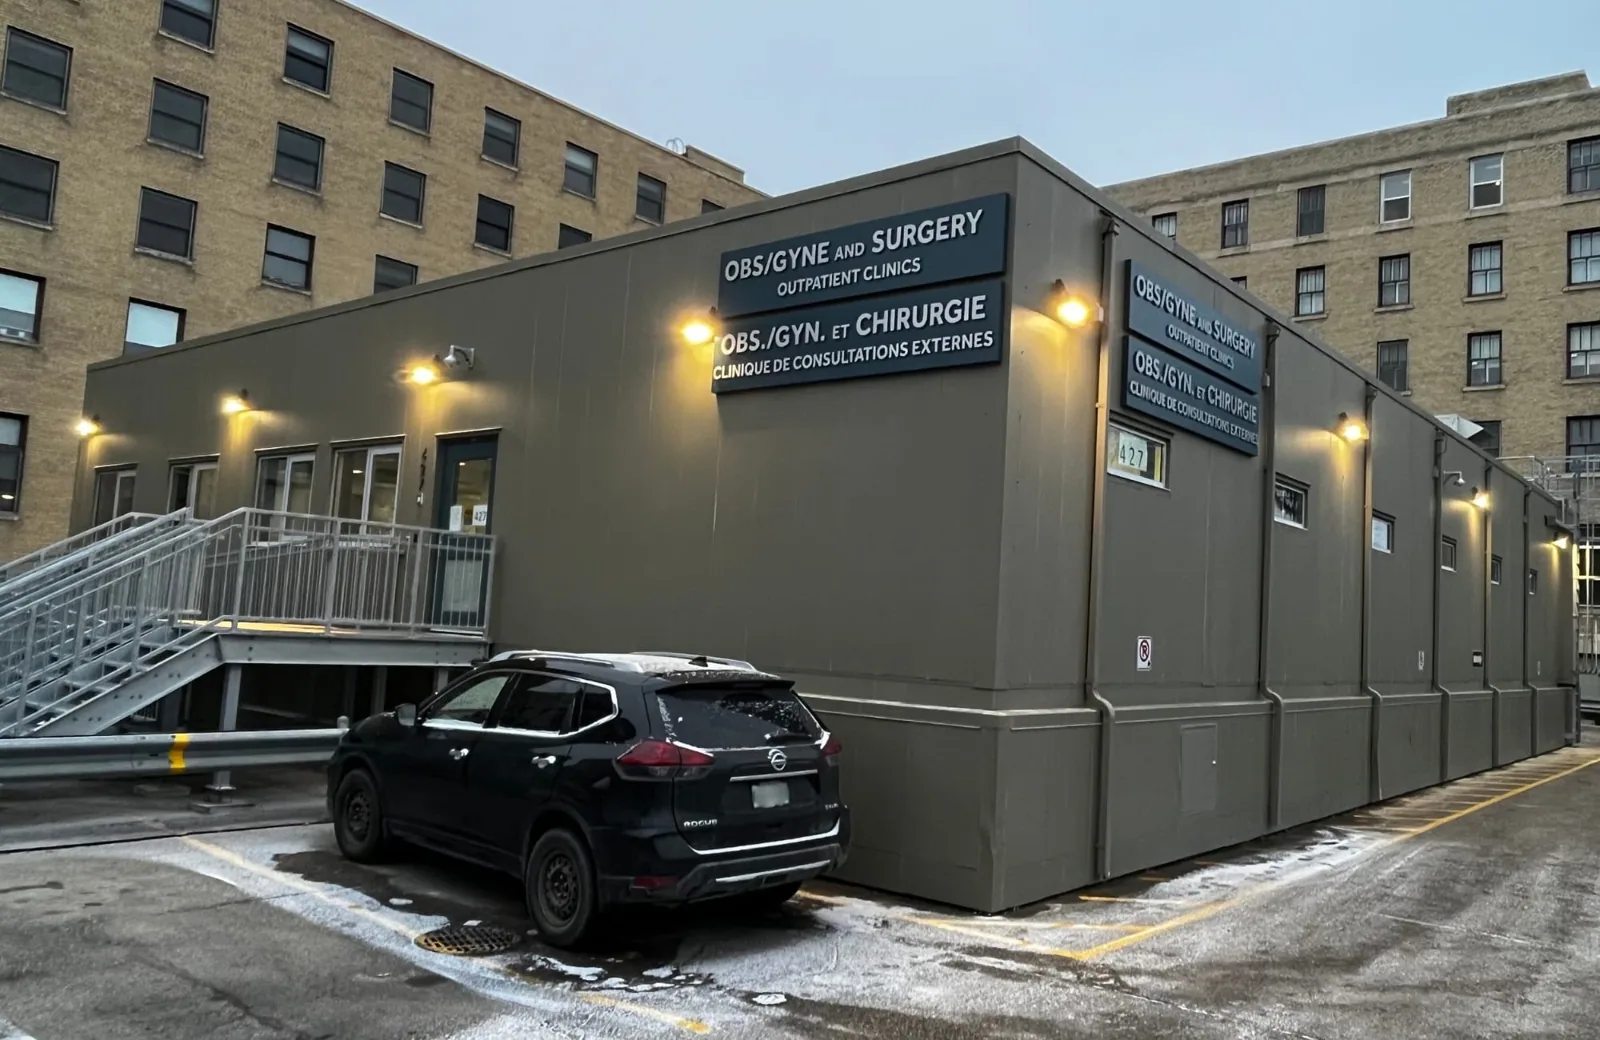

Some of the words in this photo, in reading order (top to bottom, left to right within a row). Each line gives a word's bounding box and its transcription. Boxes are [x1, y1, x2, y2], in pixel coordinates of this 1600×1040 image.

[724, 241, 831, 282] OBS/GYNE
[834, 242, 865, 262] AND
[871, 209, 983, 254] SURGERY
[777, 268, 861, 297] OUTPATIENT
[862, 257, 921, 282] CLINICS
[720, 321, 826, 356] OBS./GYN.
[832, 323, 850, 340] ET
[855, 295, 986, 337] CHIRURGIE
[1136, 275, 1196, 326] OBS/GYNE
[1197, 318, 1212, 335] AND
[1213, 320, 1256, 359] SURGERY
[713, 360, 771, 381] CLINIQUE
[772, 357, 791, 373] DE
[792, 341, 909, 370] CONSULTATIONS
[911, 330, 994, 356] EXTERNES
[1168, 324, 1210, 356] OUTPATIENT
[1210, 348, 1234, 369] CLINICS
[1130, 380, 1167, 408] CLINIQUE
[1167, 396, 1178, 412] DE
[1177, 401, 1230, 434] CONSULTATIONS
[1135, 350, 1195, 396] OBS./GYN.
[1196, 386, 1206, 400] ET
[1207, 385, 1257, 423] CHIRURGIE
[1119, 444, 1144, 467] 427
[474, 511, 487, 522] 427
[683, 818, 718, 828] ROGUE
